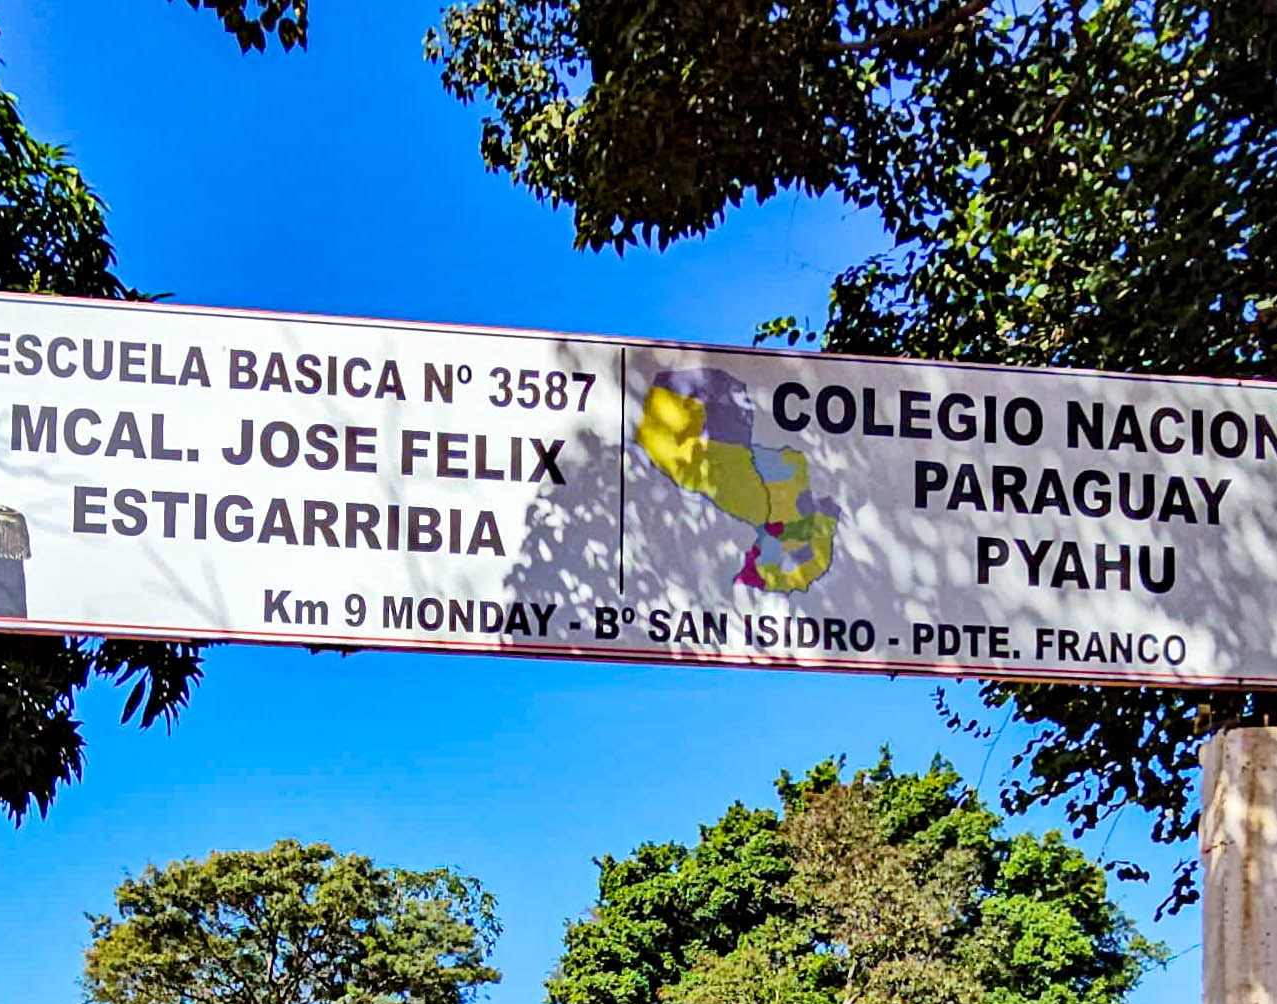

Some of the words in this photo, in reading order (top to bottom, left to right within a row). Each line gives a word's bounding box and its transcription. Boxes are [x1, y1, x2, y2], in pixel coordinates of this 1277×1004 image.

[229, 350, 408, 402] BASICA
[488, 368, 598, 413] 3587
[772, 381, 1044, 447] COLEGIO
[10, 404, 200, 462] MCAL.
[222, 419, 376, 475] JOSE
[401, 430, 567, 485] FELIX
[72, 485, 507, 558] ESTIGARRIBIA
[914, 460, 1232, 526] PARAGUAY
[976, 537, 1177, 594] PYAHU
[263, 588, 329, 626] Km
[344, 593, 367, 628] 9
[382, 595, 557, 637] MONDAY
[648, 609, 727, 645] SAN
[744, 613, 876, 653] ISIDRO
[912, 622, 1021, 660] PDTE.
[1034, 628, 1188, 666] FRANCO
